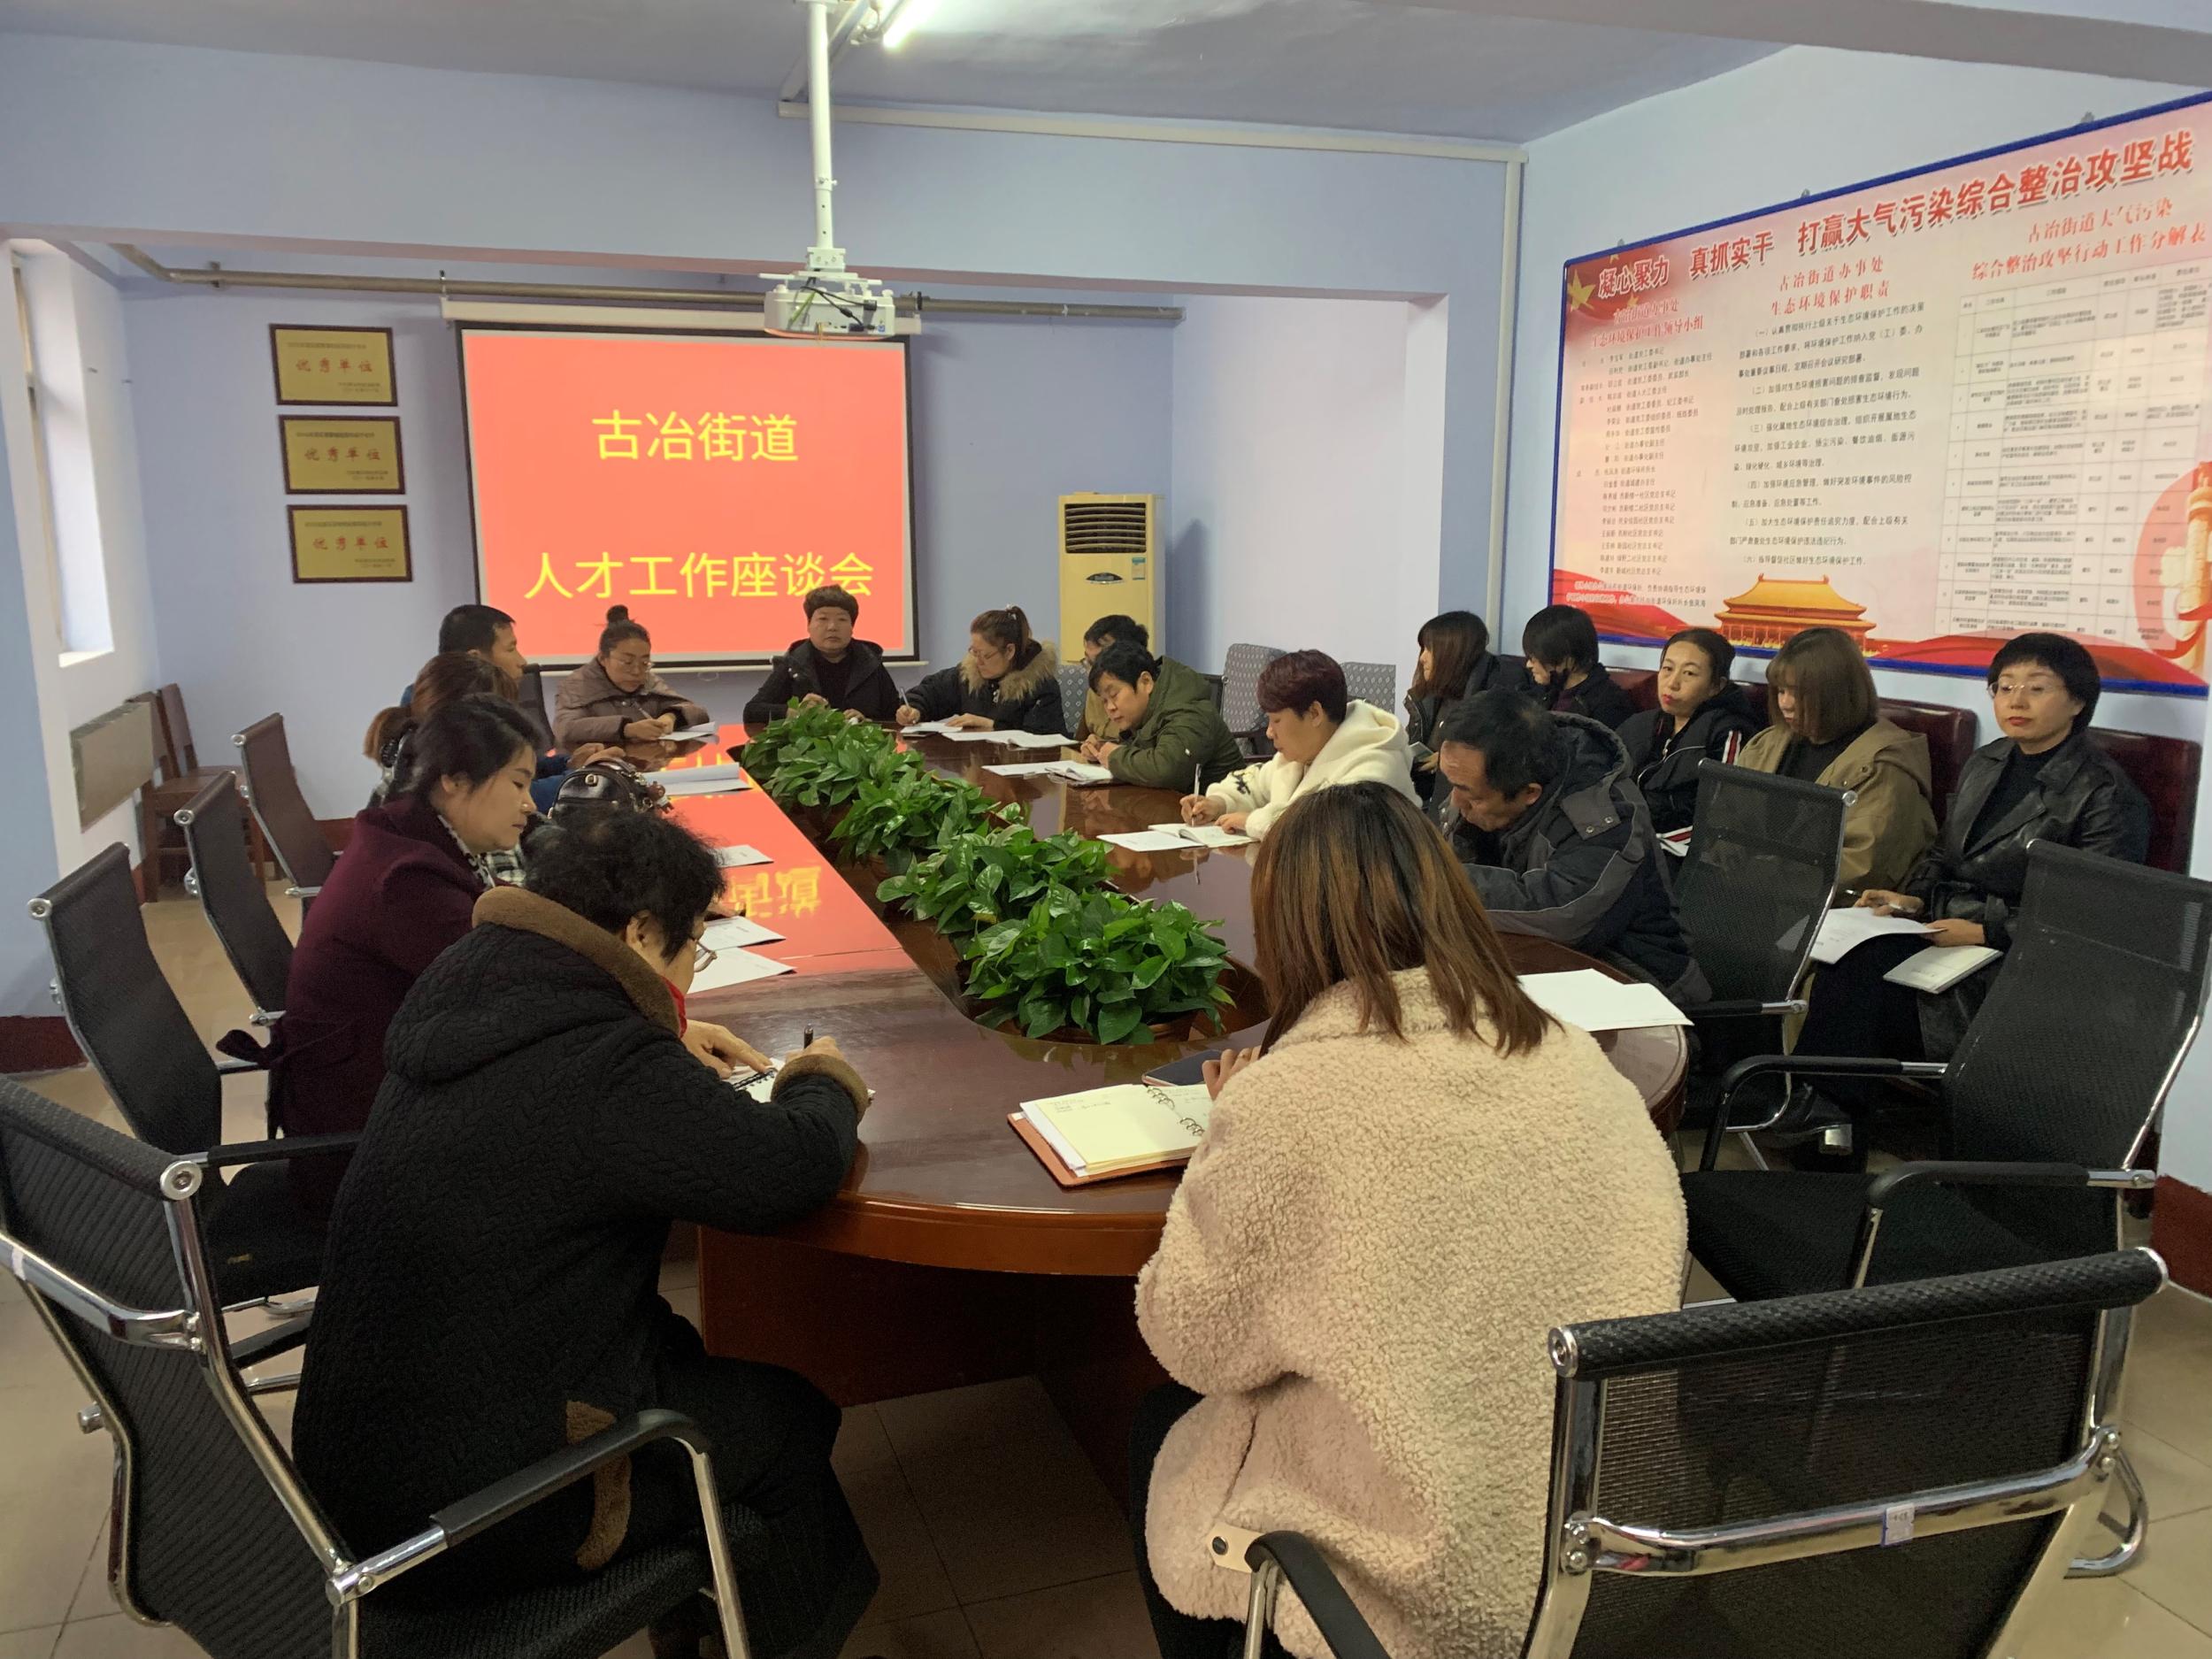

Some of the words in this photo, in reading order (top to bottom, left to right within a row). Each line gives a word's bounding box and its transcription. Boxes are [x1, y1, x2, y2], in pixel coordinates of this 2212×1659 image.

[1598, 256, 1669, 298] 凝心聚力
[1690, 231, 1774, 279] 真抓实干
[1797, 130, 2193, 255] 打赢大气污染综合整治攻坚战
[2029, 197, 2172, 243] 古冶街道大气污染
[1973, 221, 2206, 280] 综合整治攻坚行动工作分解表
[1779, 255, 1883, 291] 古冶街道办事处
[1771, 281, 1889, 316] 生态环境保护职责
[296, 357, 373, 373] 优秀单位
[304, 446, 380, 462] 优秀单位
[592, 410, 798, 461] 古冶街道
[313, 535, 388, 550] 优秀单位
[525, 552, 873, 598] 人才工作座谈会
